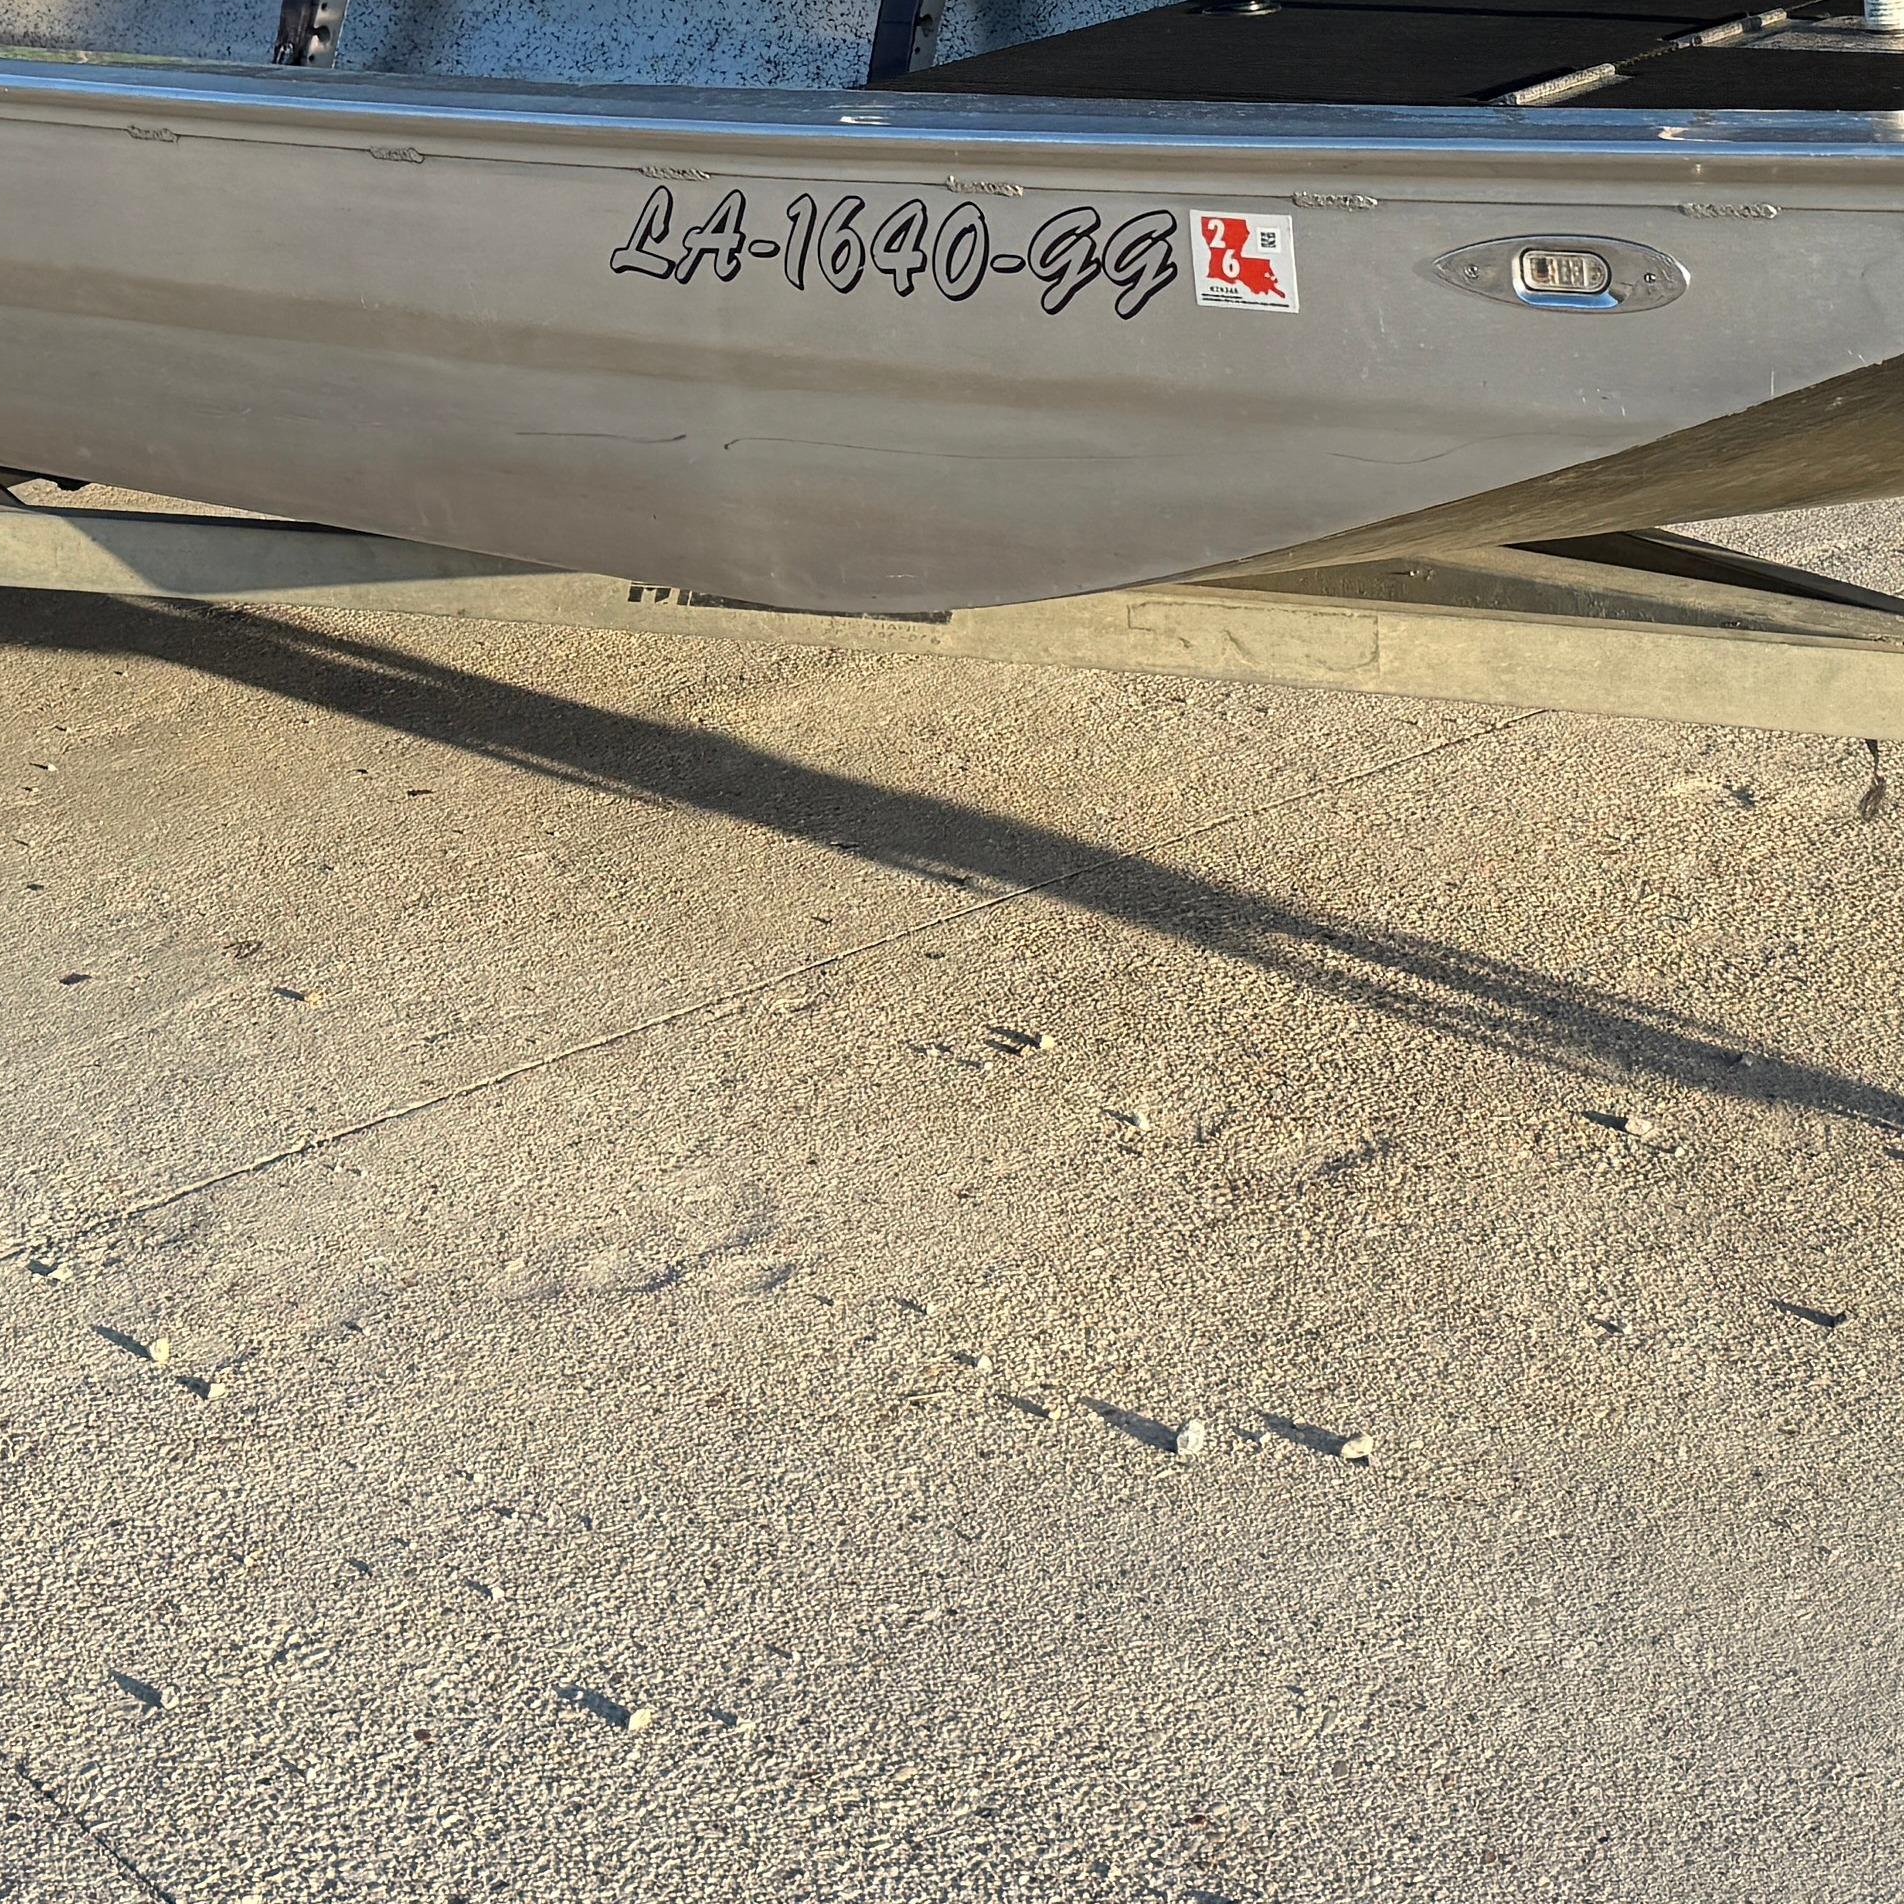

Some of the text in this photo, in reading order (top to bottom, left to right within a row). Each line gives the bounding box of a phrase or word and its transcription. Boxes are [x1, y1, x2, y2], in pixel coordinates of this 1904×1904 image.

[1207, 218, 1226, 249] 2
[610, 185, 1179, 320] LA-1640-GG
[1222, 248, 1241, 279] 6
